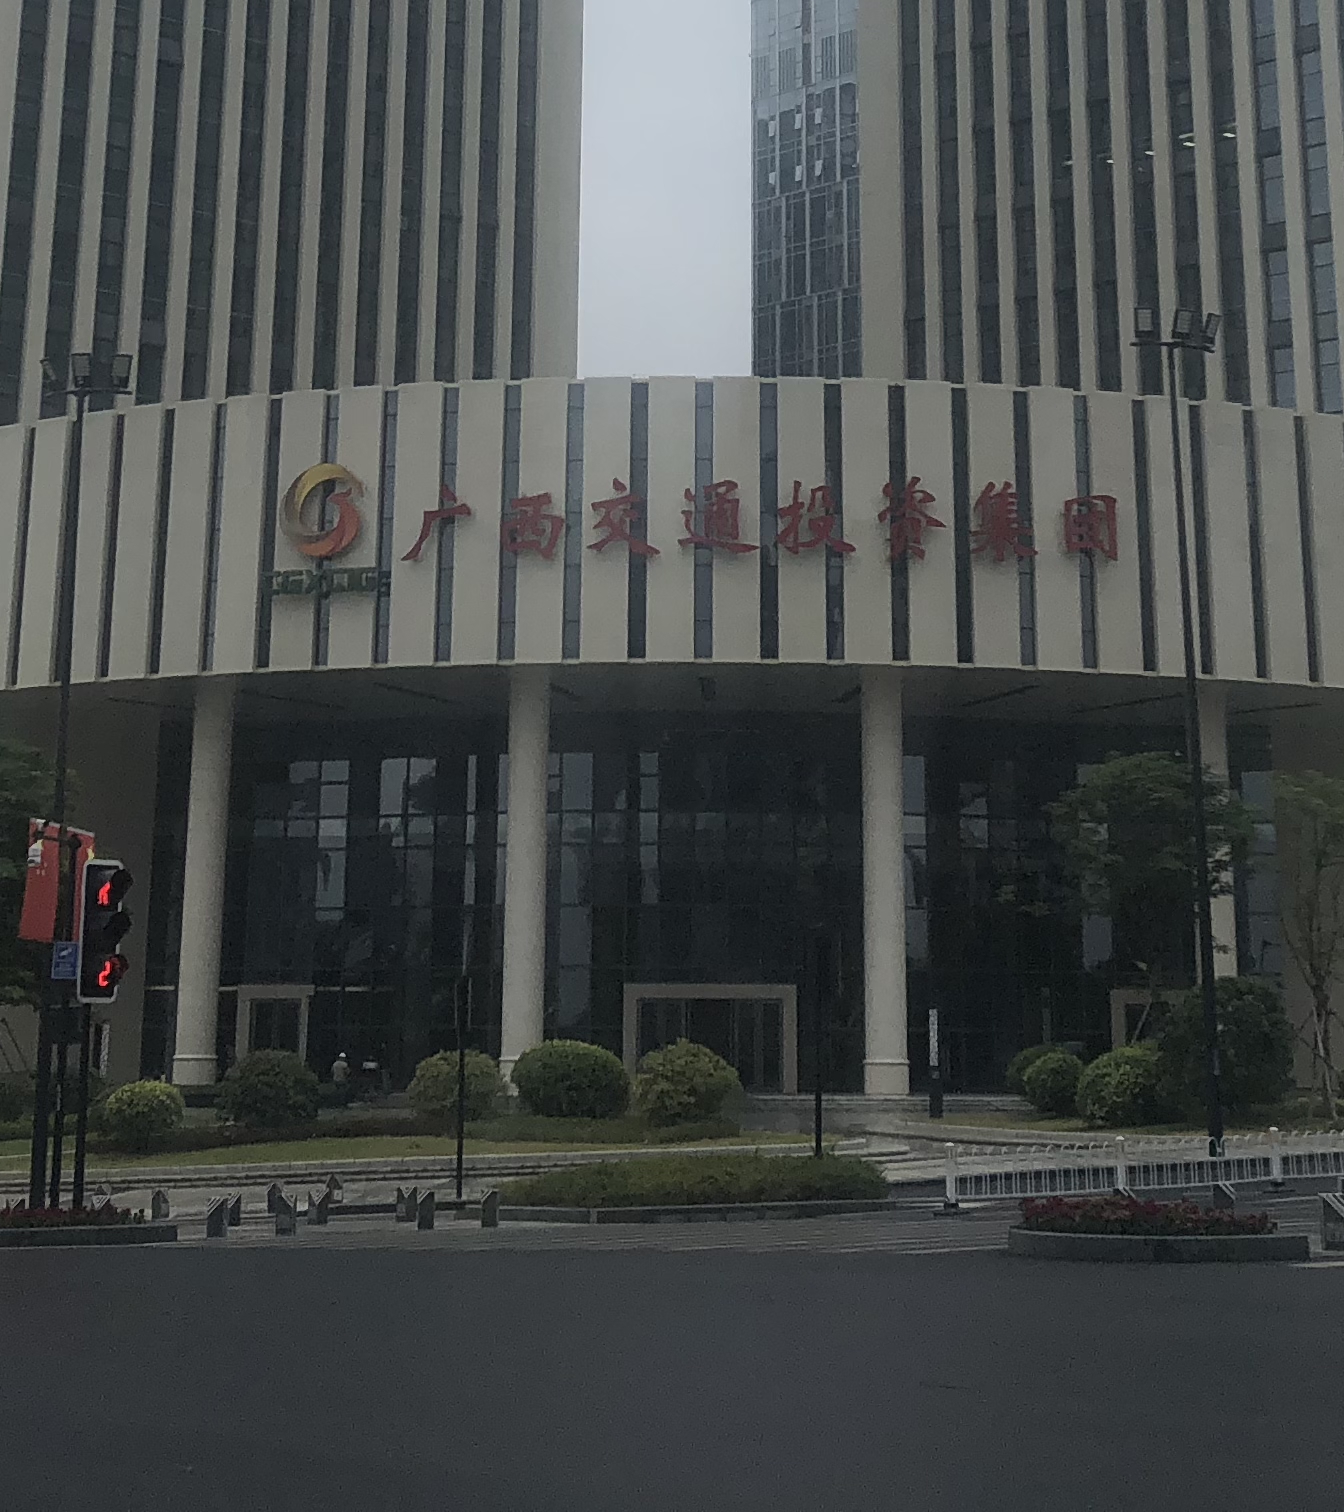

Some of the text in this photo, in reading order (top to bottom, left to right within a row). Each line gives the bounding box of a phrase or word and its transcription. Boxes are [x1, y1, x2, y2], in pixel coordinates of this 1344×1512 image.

[400, 475, 1119, 562] 广西交通投资集团
